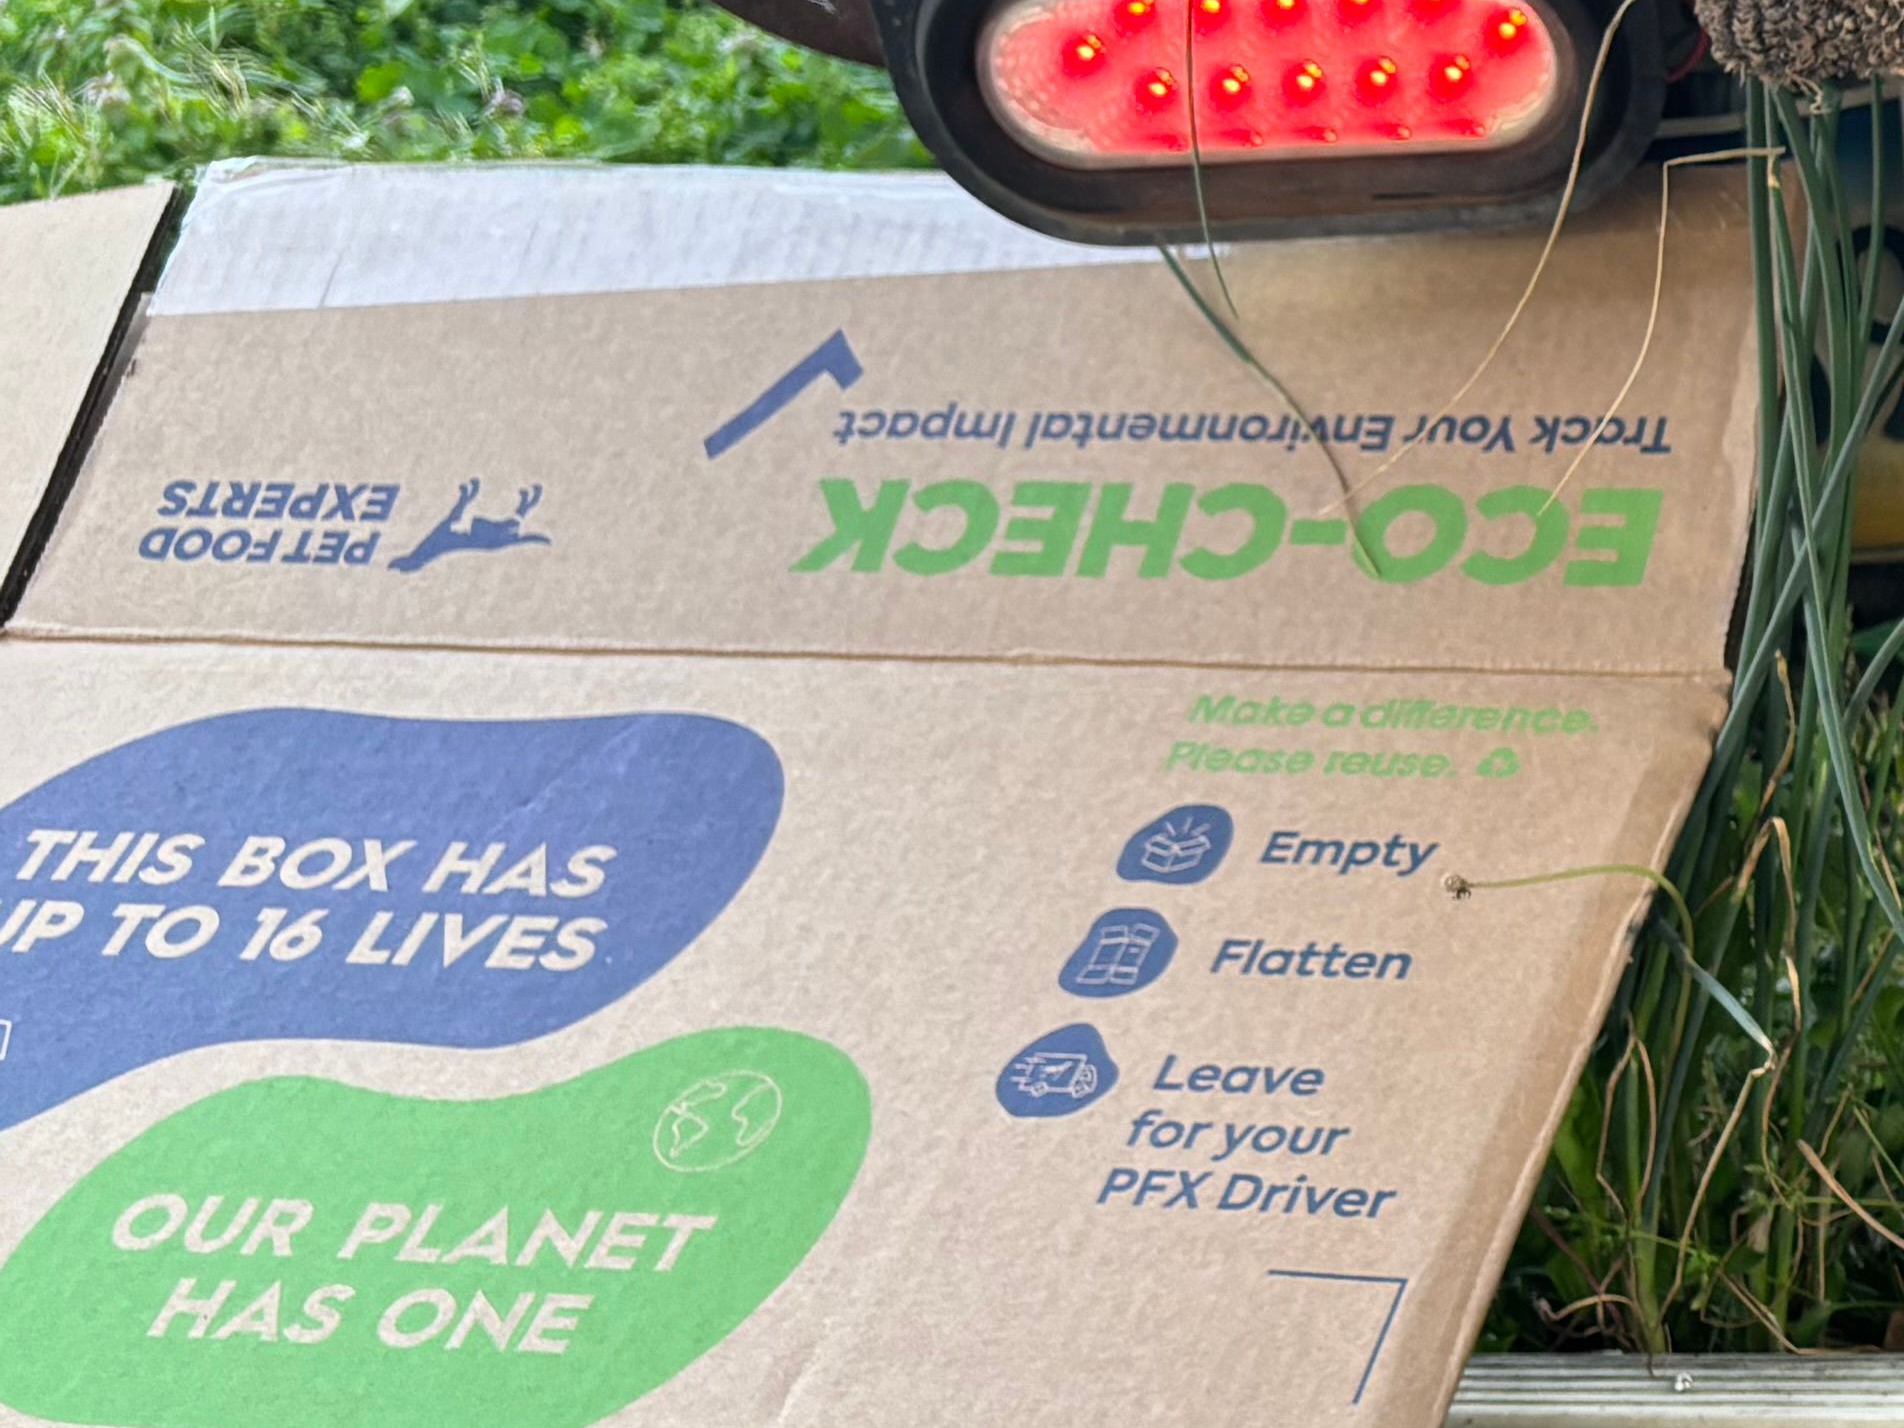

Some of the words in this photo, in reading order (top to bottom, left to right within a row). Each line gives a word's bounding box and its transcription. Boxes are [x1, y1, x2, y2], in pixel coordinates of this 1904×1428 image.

[833, 402, 1017, 448] Impact
[1025, 411, 1395, 451] Environmental
[1403, 414, 1516, 453] Your
[1530, 415, 1672, 454] Track
[157, 479, 400, 522] EXPERTS
[138, 527, 283, 562] FOOD
[281, 529, 382, 565] PET
[788, 478, 1664, 587] ECO-CHECK
[1188, 694, 1316, 727] Make
[1322, 701, 1355, 728] a
[1360, 698, 1598, 734] difference.
[1166, 740, 1315, 773] Please
[1323, 749, 1458, 778] reuse.
[16, 829, 206, 885] THIS
[216, 836, 417, 892] BOX
[421, 841, 617, 898] HAS
[1259, 830, 1440, 876] Empty
[101, 905, 220, 958] TO
[238, 907, 329, 961] 16
[345, 911, 608, 972] LIVES
[1210, 938, 1413, 980] Flatten
[1152, 1054, 1326, 1096] Leave
[1126, 1109, 1214, 1150] for
[1210, 1121, 1351, 1162] your
[1096, 1168, 1214, 1210] PFX
[1216, 1174, 1398, 1220] Driver
[111, 1193, 315, 1257] OUR
[336, 1201, 718, 1272] PLANET
[146, 1277, 356, 1345] HAS
[375, 1288, 595, 1355] ONE
